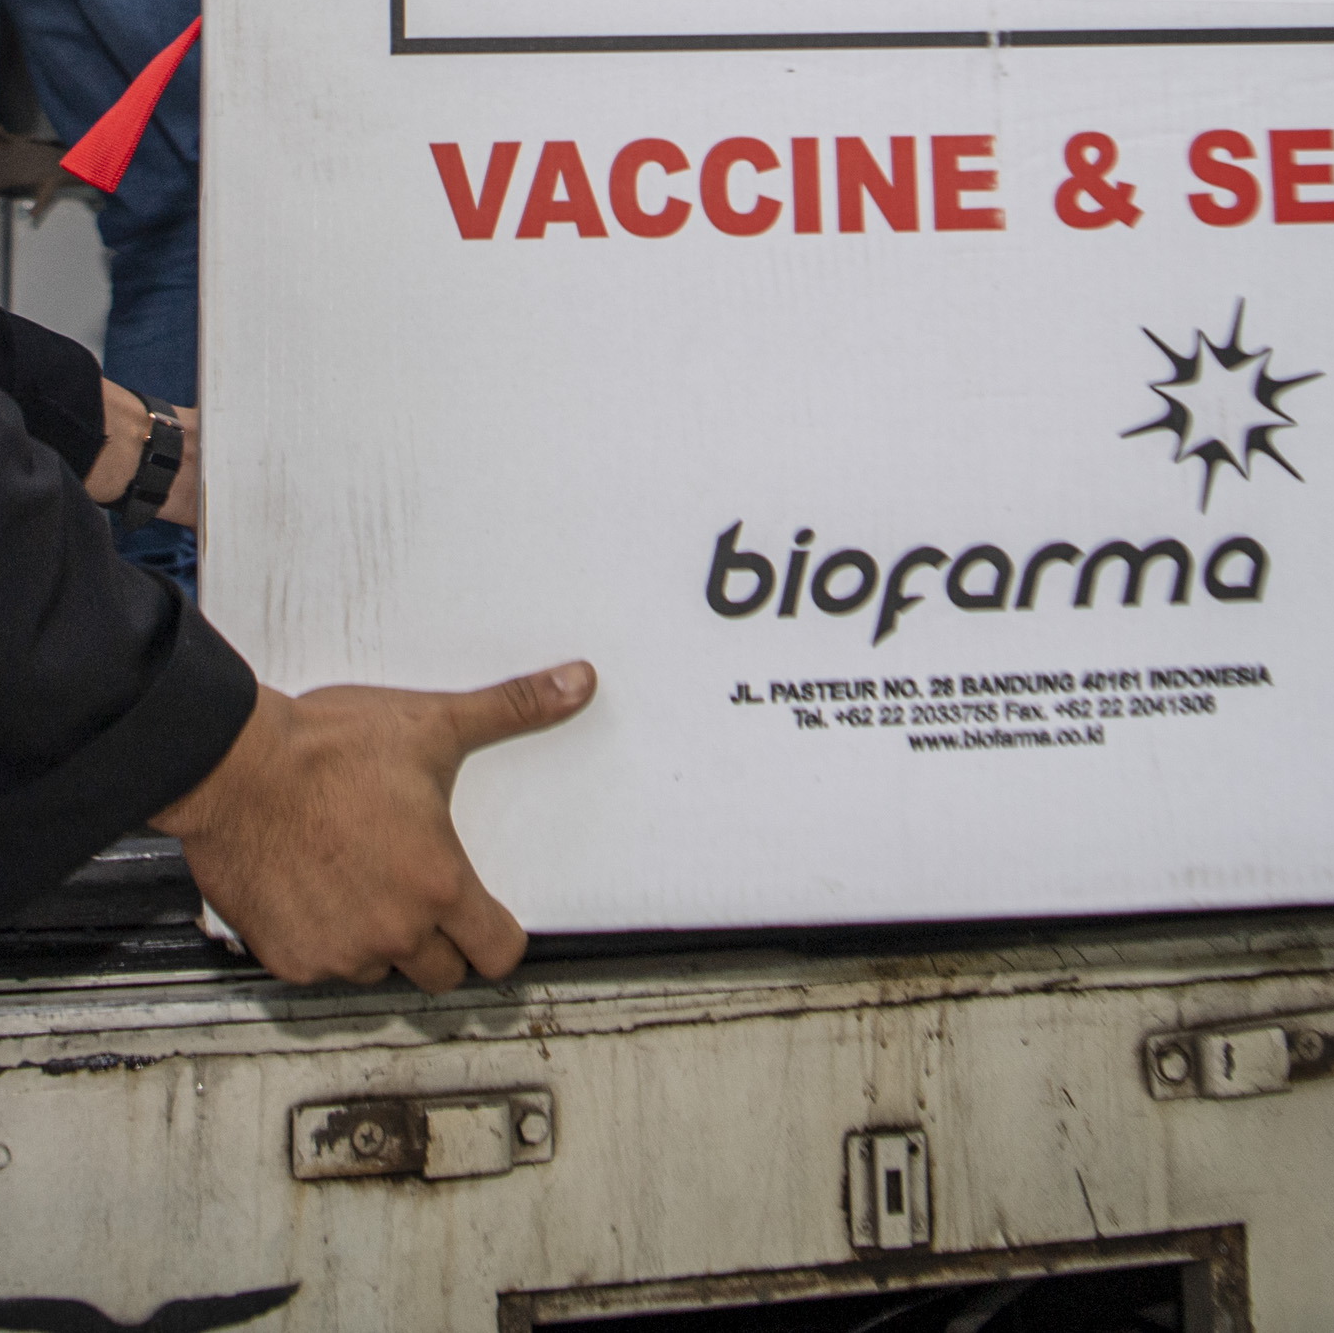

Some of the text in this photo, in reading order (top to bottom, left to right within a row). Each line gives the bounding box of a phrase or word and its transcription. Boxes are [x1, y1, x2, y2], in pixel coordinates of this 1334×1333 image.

[428, 135, 1006, 241] VACCINE
[1053, 131, 1143, 231] &
[704, 520, 1270, 647] biofarma
[769, 679, 878, 703] PASTEUR
[883, 678, 925, 700] NO.
[929, 676, 957, 698] 28
[960, 672, 1077, 696] BANDUNG
[1149, 665, 1273, 690] INDONESIA
[792, 708, 829, 729] Tel.
[834, 706, 875, 728] +62
[879, 705, 905, 727] 22
[1004, 701, 1048, 722] Fax.
[1053, 699, 1094, 720] +62
[1098, 697, 1125, 718] 22
[907, 725, 1106, 752] www.biofarma.co.id
